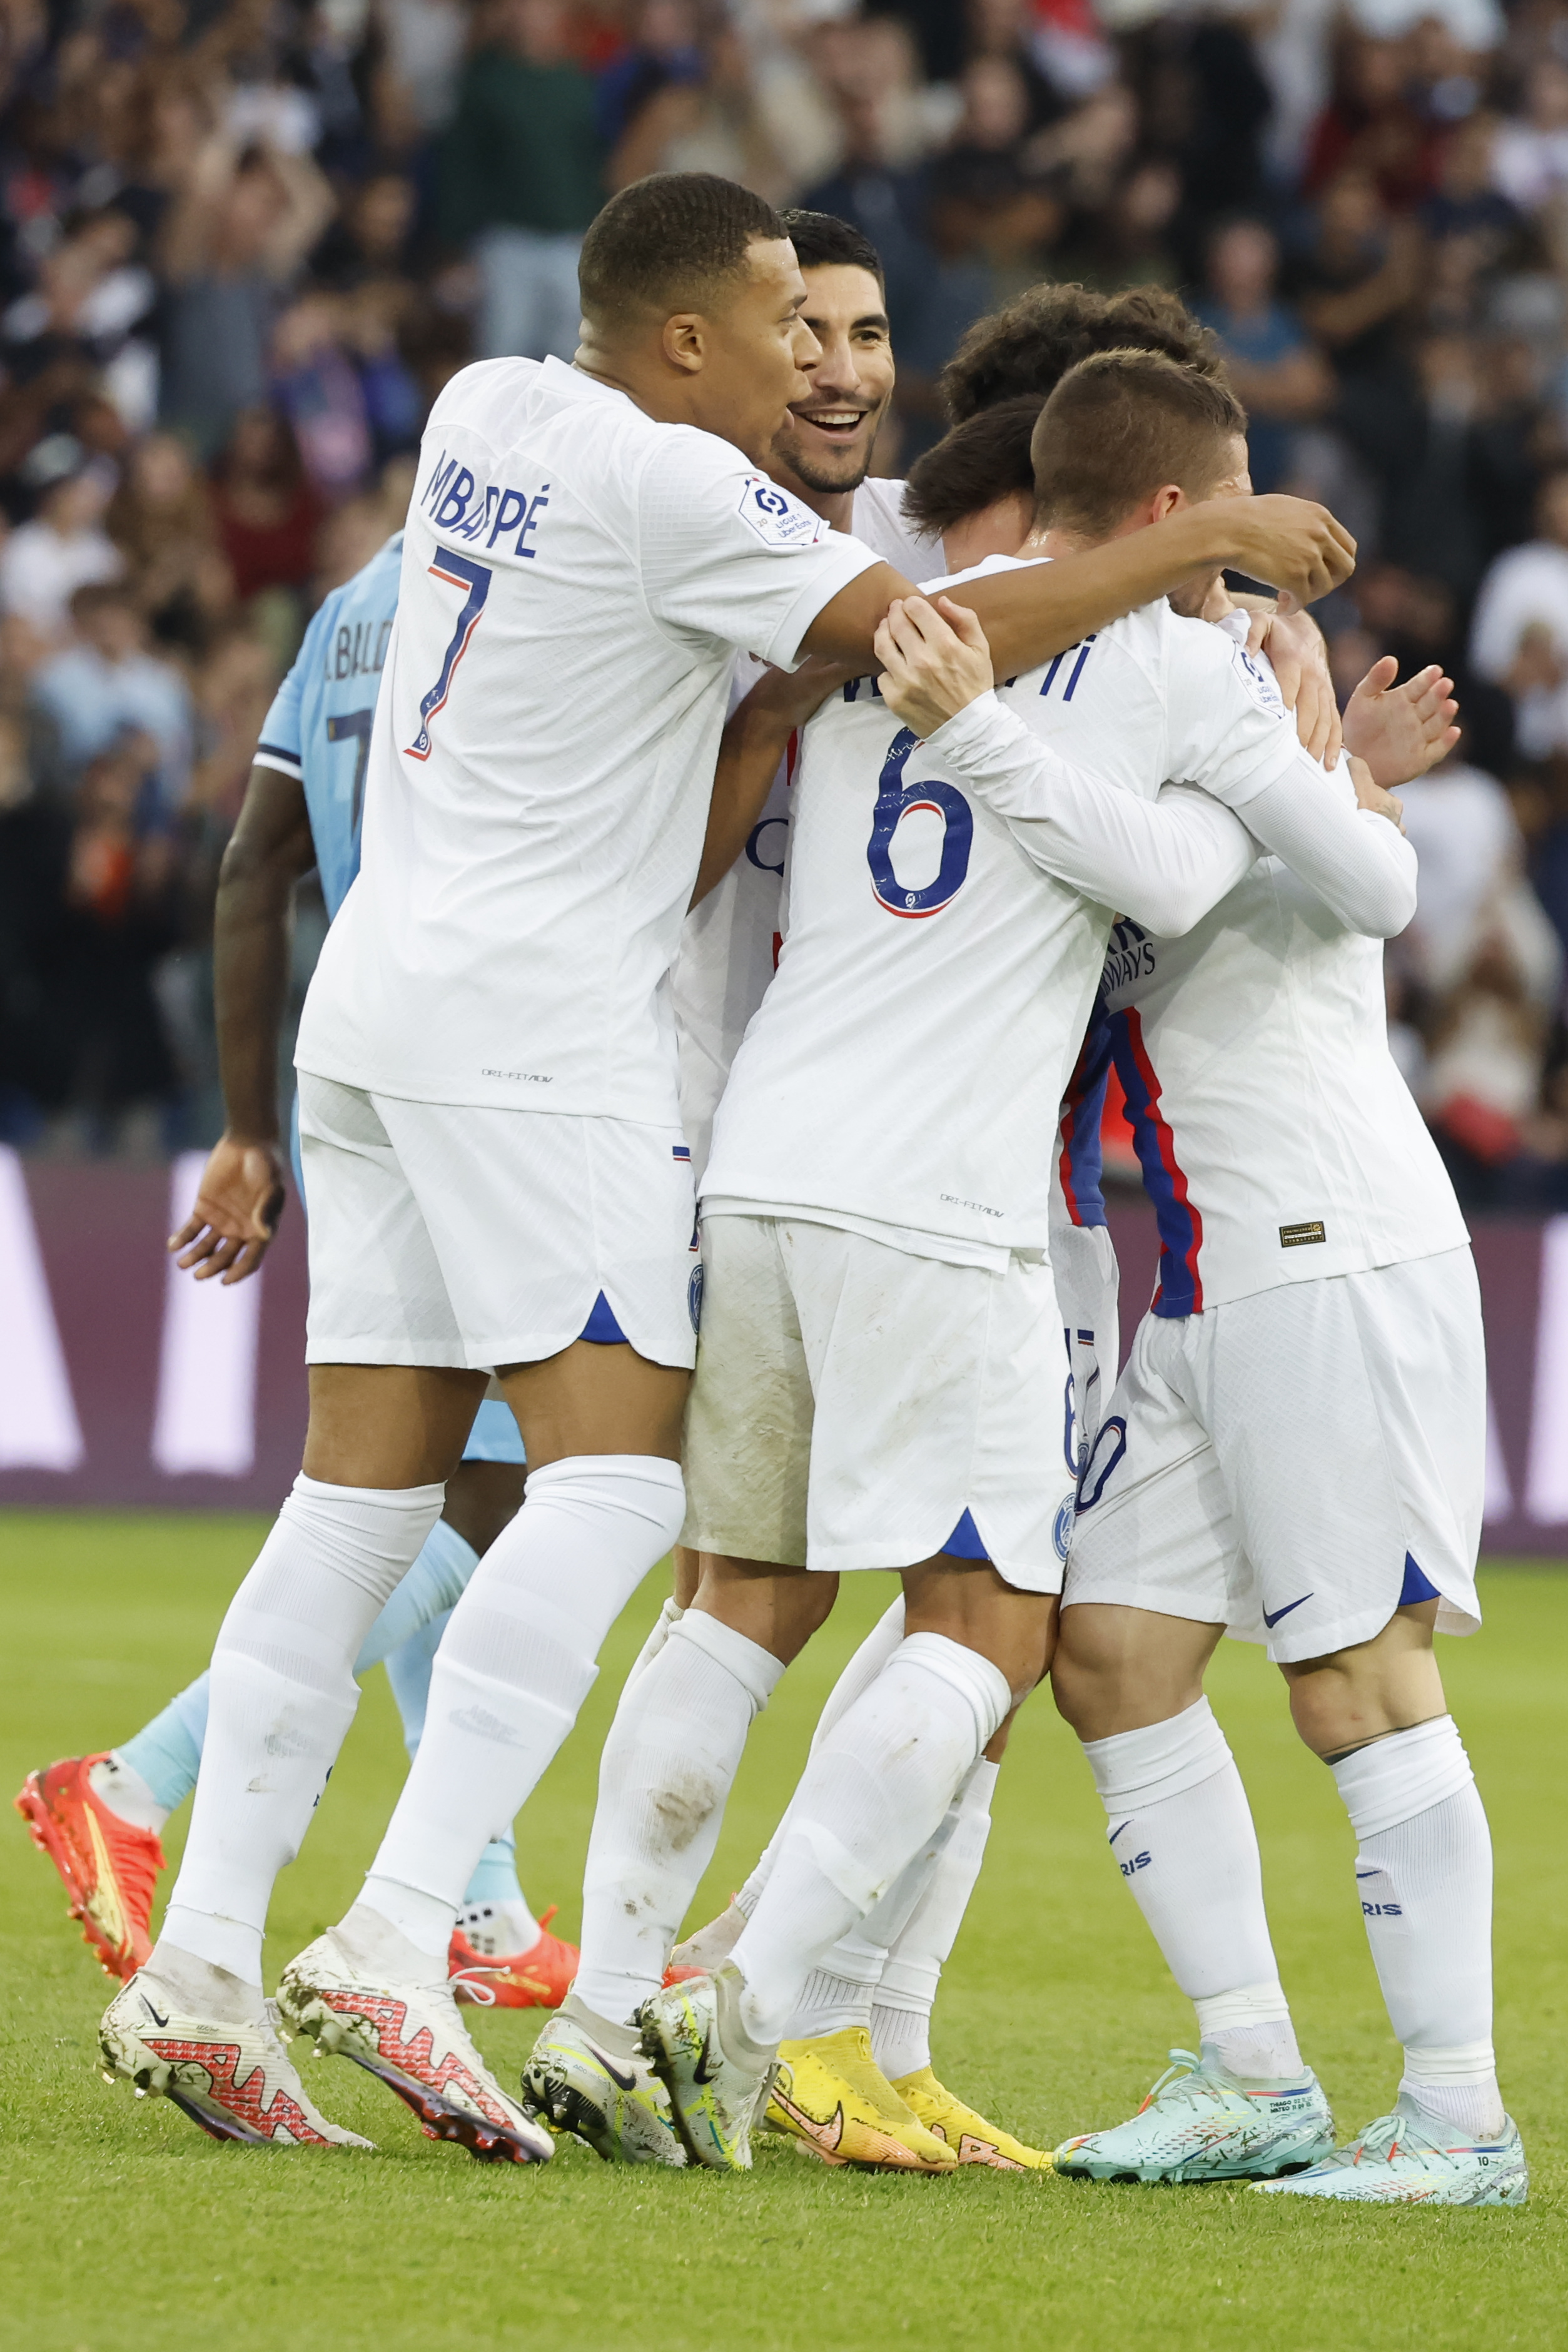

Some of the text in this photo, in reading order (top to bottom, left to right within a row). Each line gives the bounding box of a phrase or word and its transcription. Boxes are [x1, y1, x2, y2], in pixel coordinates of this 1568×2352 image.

[420, 449, 550, 559] MBAPPÉ
[757, 518, 768, 527] 20
[776, 515, 798, 529] LIGUE
[778, 527, 796, 538] Uber
[795, 520, 812, 529] Eats
[403, 545, 493, 762] 7
[327, 708, 373, 842] 7
[867, 726, 974, 919] 6
[1270, 2100, 1292, 2108] THIAGO
[1270, 2106, 1290, 2114] MATEO
[1477, 2156, 1489, 2166] 10
